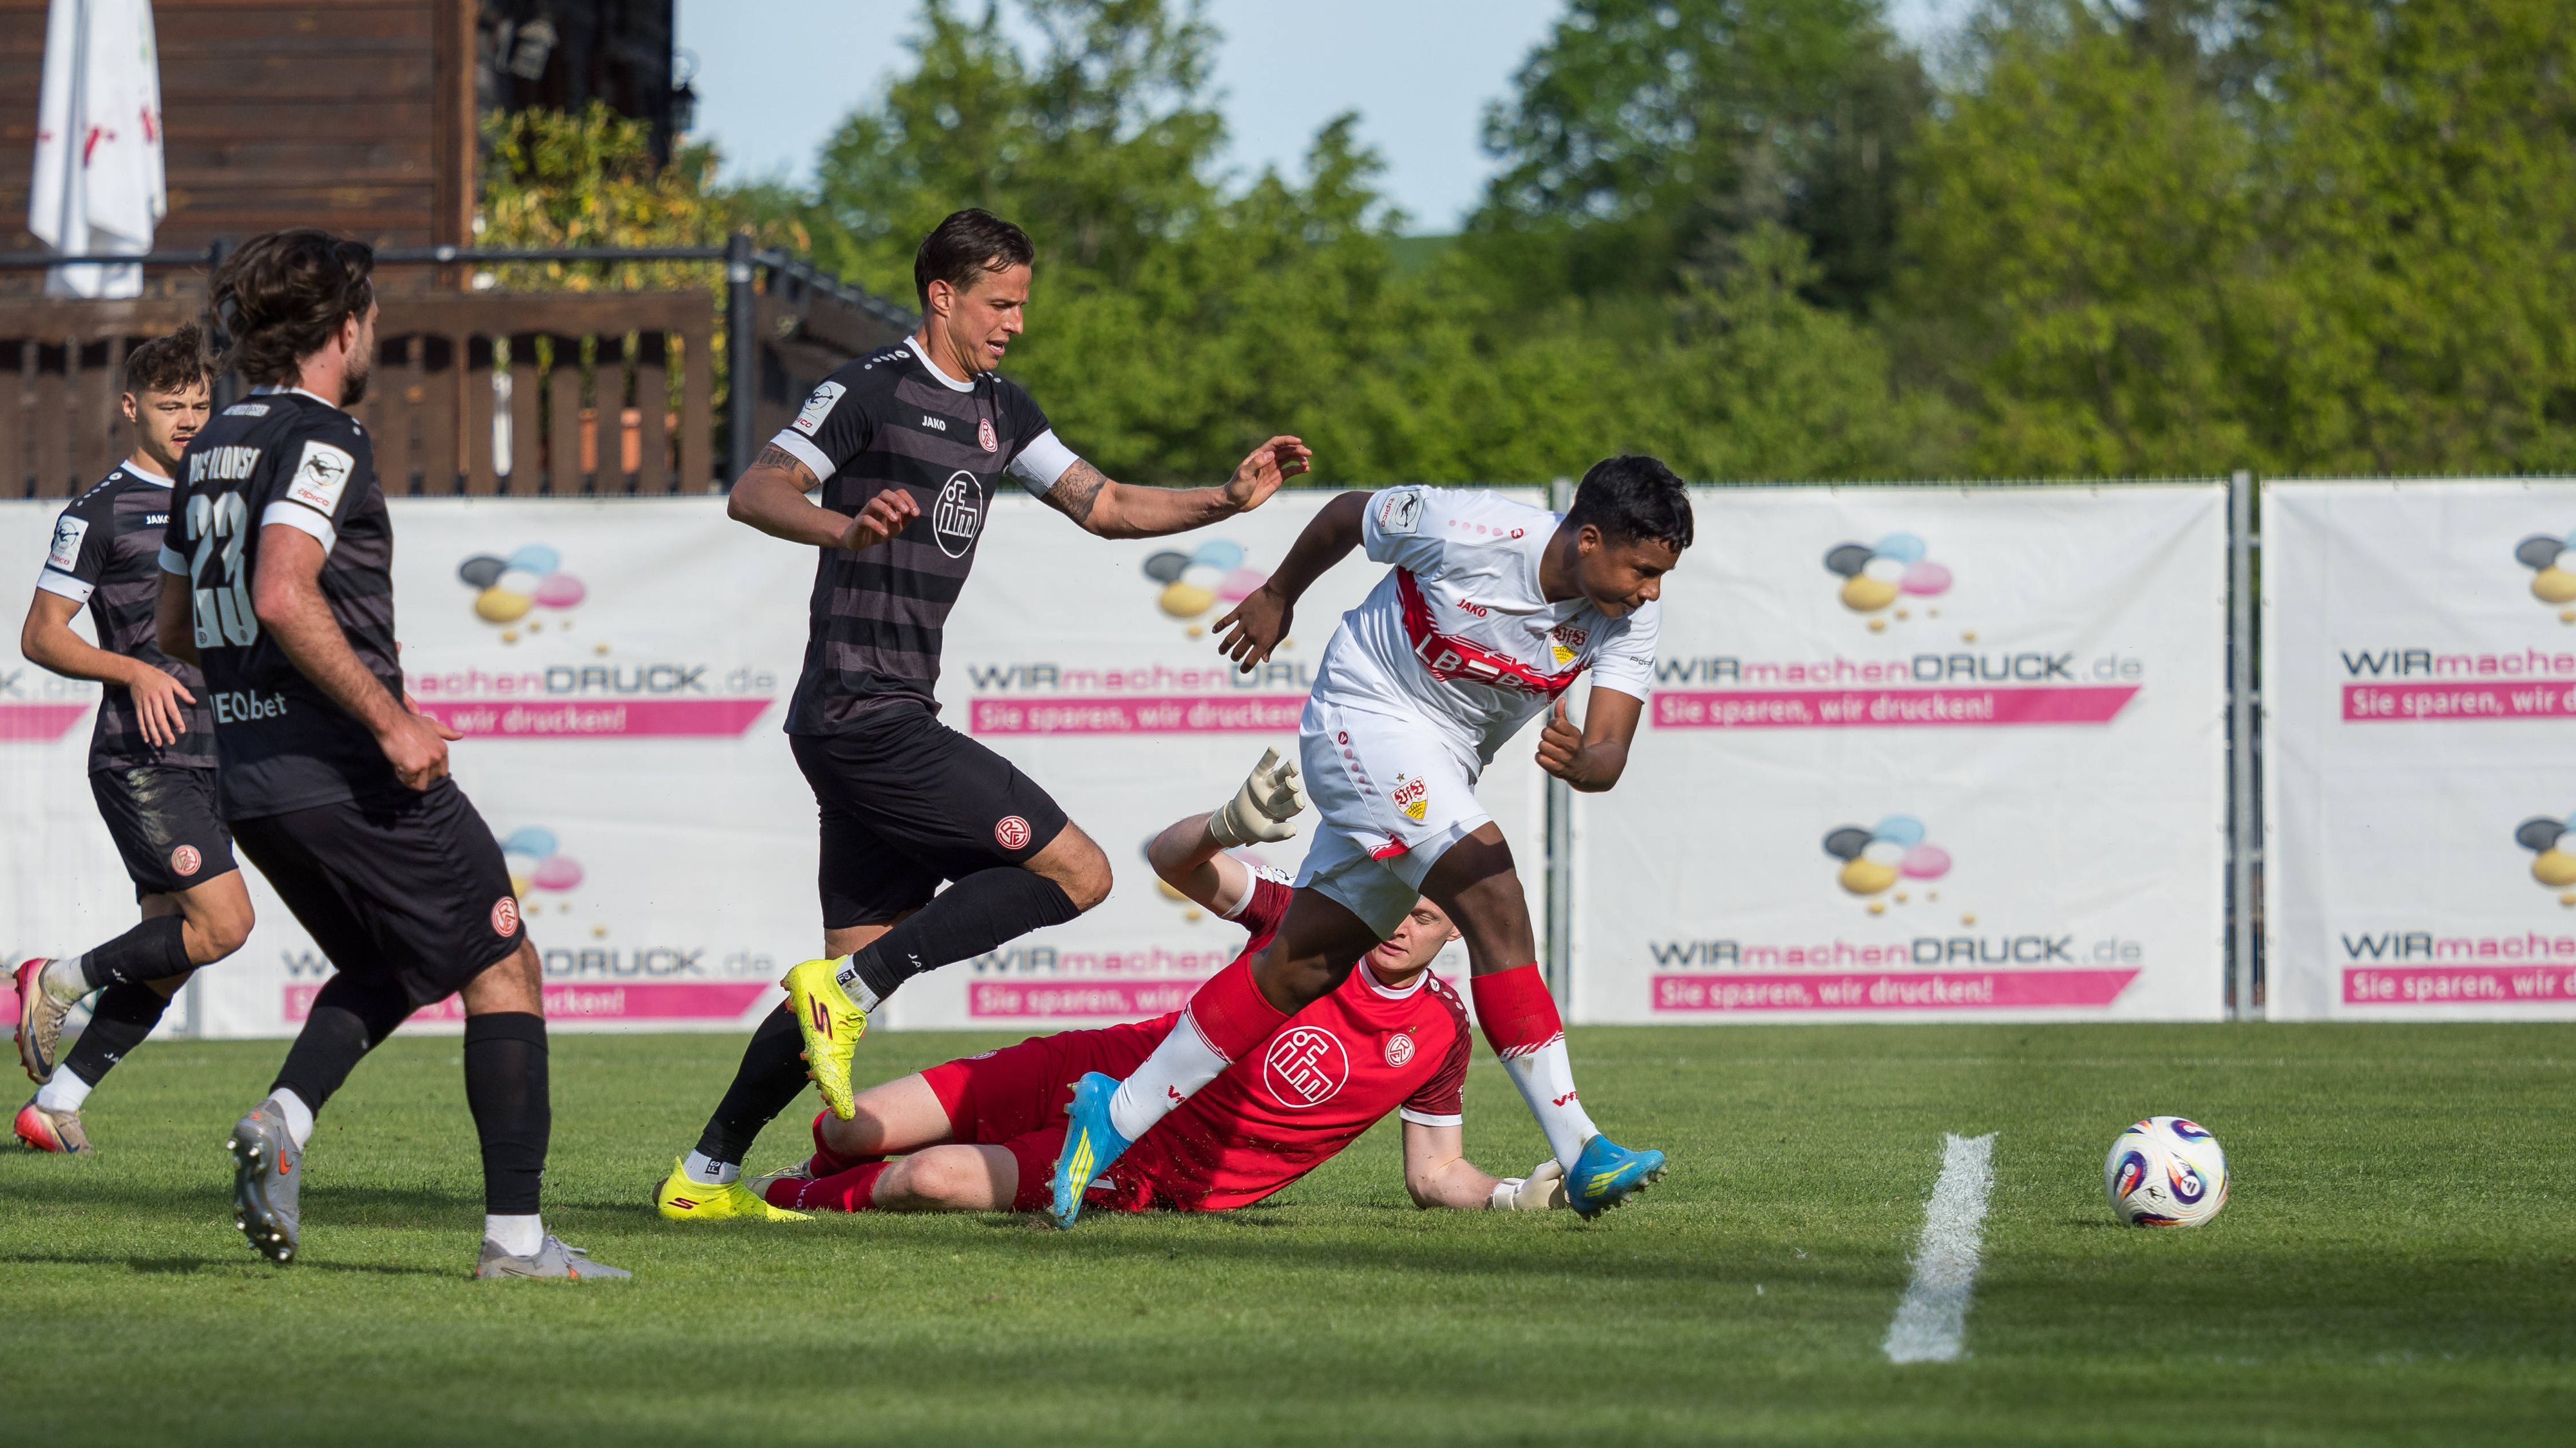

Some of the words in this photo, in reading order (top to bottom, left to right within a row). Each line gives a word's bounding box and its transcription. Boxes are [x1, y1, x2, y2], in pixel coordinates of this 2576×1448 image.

[922, 415, 946, 432] JAKO
[938, 480, 978, 538] ifm
[1381, 497, 1396, 527] tipico
[1456, 598, 1488, 618] JAKO
[1653, 653, 2144, 684] WIRmachenDRUCK.de
[502, 703, 627, 733] drucken!
[978, 701, 1024, 730] Sie
[1136, 700, 1183, 729] wir
[1660, 696, 1705, 724] Sie
[1709, 700, 1812, 728] sparen,
[1819, 696, 1862, 721] wir
[1870, 694, 1994, 721] drucken!
[2352, 689, 2396, 716] Sie
[2402, 692, 2504, 720] sparen,
[2511, 685, 2557, 713] wir
[1394, 779, 1425, 808] VfB
[1650, 935, 2145, 968] WIRmachenDRUCK.de
[978, 985, 1022, 1014] Sie
[1135, 984, 1183, 1011] wir
[1660, 980, 1705, 1007] Sie
[1709, 983, 1812, 1011] sparen,
[1819, 980, 1862, 1005] wir
[1870, 977, 1994, 1004] drucken!
[2352, 973, 2396, 1000] Sie
[2402, 976, 2505, 1004] sparen,
[2511, 969, 2557, 998] wir
[1269, 1031, 1333, 1103] ifm
